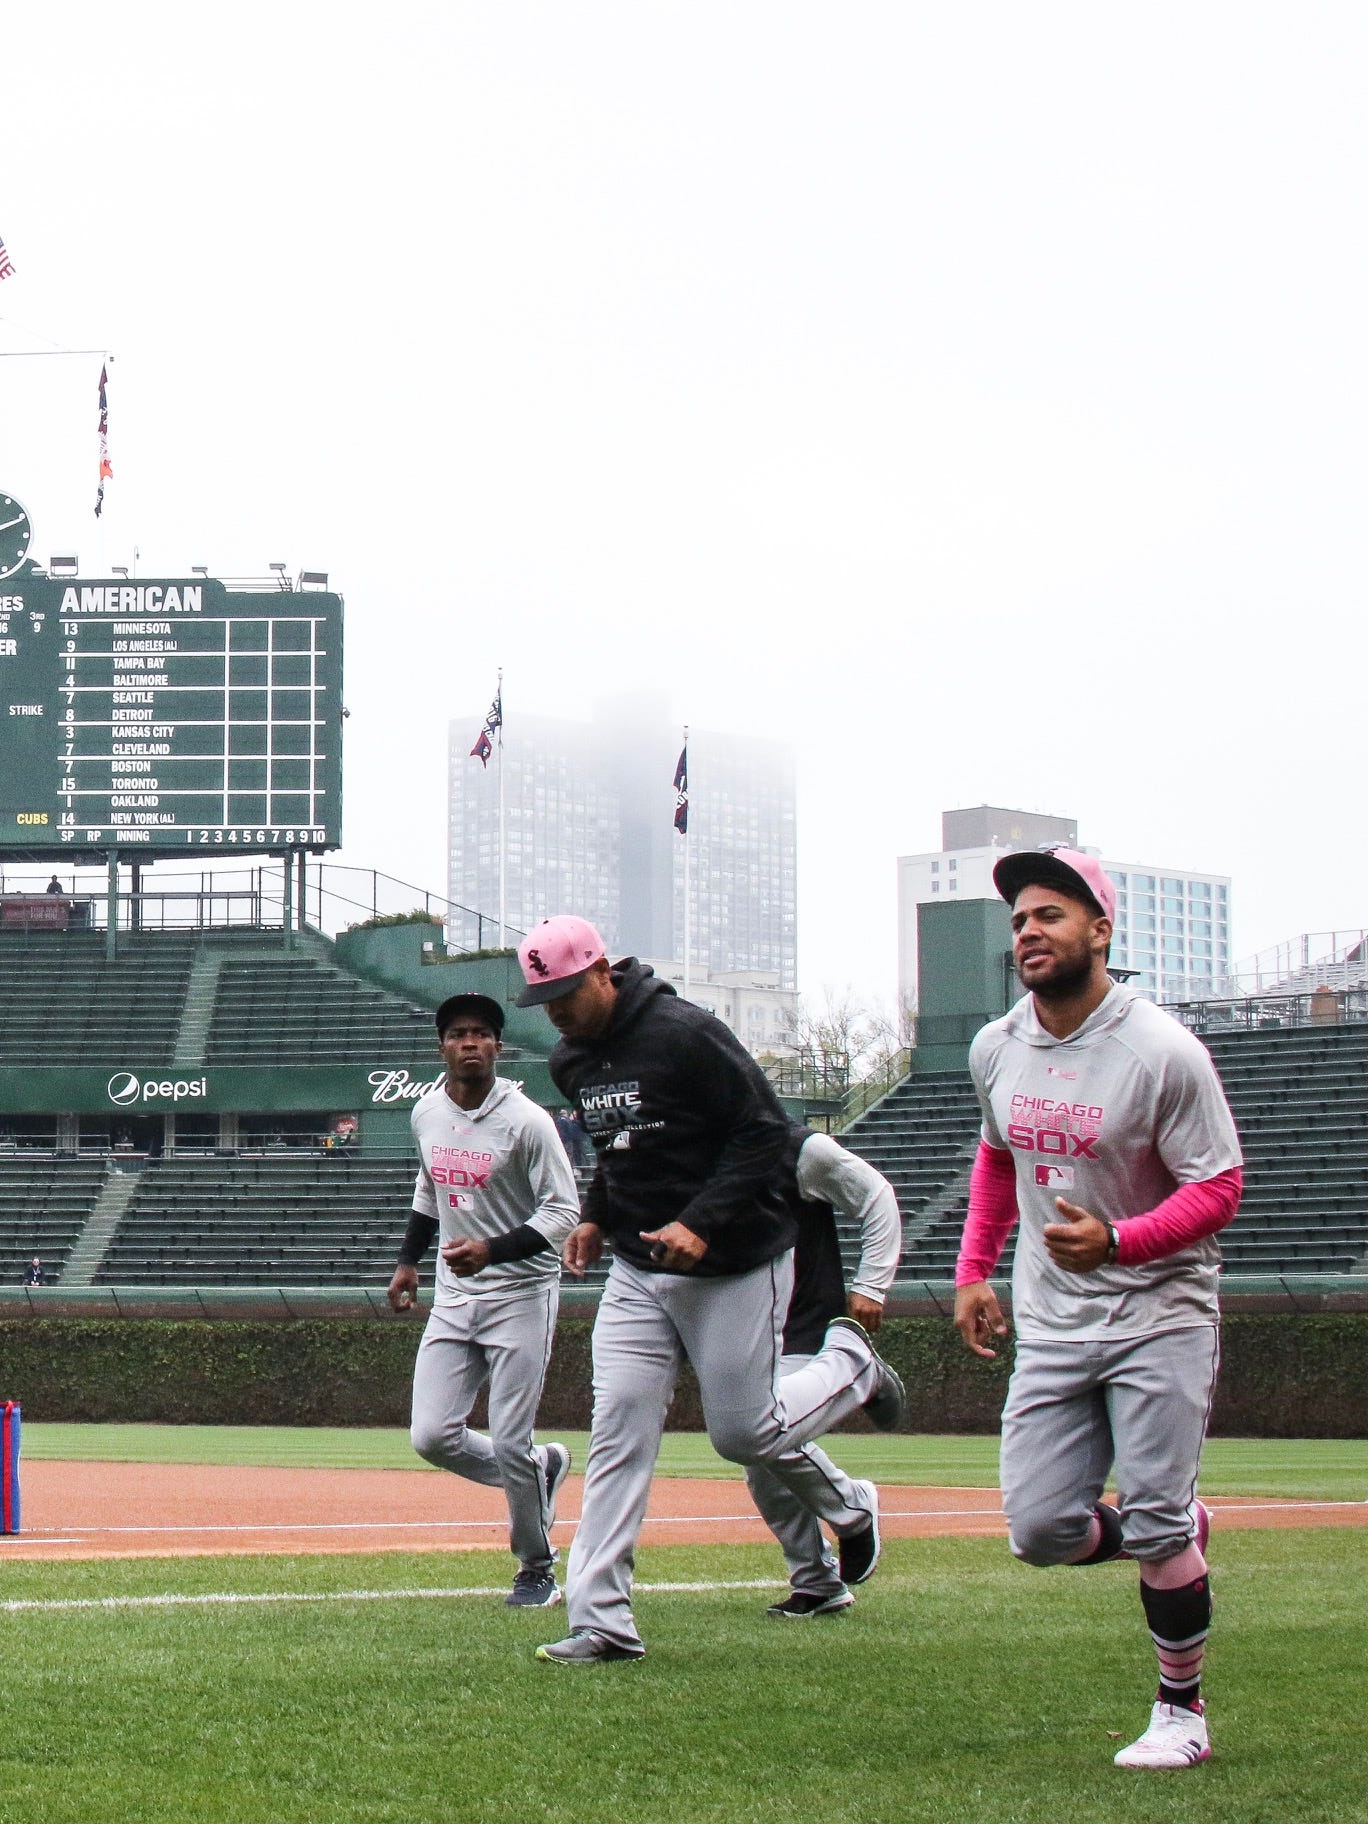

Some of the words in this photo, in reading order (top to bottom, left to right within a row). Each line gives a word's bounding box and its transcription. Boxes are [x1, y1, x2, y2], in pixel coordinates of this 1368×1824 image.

[59, 585, 202, 613] AMERICAN
[29, 611, 46, 621] 3RD
[33, 621, 42, 633] 9
[64, 622, 79, 636] 13
[113, 622, 172, 635] MINNESOTA
[66, 639, 76, 653] 9
[112, 639, 128, 652] LOS
[112, 657, 146, 670] TAMPA
[146, 657, 166, 670] BAY
[65, 674, 76, 687] 4
[113, 674, 169, 687] BALTIMORE
[65, 691, 75, 705] 7
[112, 691, 155, 704] SEATTLE
[8, 704, 44, 716] STRIKE
[65, 708, 75, 722] 8
[111, 708, 154, 721] DETROIT
[65, 725, 75, 739] 3
[111, 725, 151, 738] KANSAS
[152, 725, 175, 738] CITY
[65, 742, 75, 756] 7
[111, 742, 171, 755] CLEVELAND
[64, 760, 74, 774] 7
[111, 760, 151, 773] BOSTON
[61, 777, 76, 791] 15
[111, 777, 159, 790] TORONTO
[110, 794, 159, 808] OAKLAND
[16, 813, 49, 825] CUBS
[61, 812, 76, 826] 14
[110, 812, 133, 825] NEW
[60, 830, 75, 842] SP
[86, 830, 102, 842] RP
[116, 830, 151, 842] INNING
[199, 830, 209, 844] 2
[213, 830, 223, 844] 3
[227, 830, 238, 843] 4
[242, 829, 252, 843] 5
[256, 830, 266, 843] 6
[271, 830, 280, 843] 7
[285, 830, 295, 844] 8
[299, 830, 309, 843] 9
[312, 830, 326, 844] 10
[142, 1076, 207, 1102] pepsi
[581, 1092, 641, 1110] WHITE
[1012, 1094, 1103, 1118] CHICAGO
[1011, 1107, 1101, 1136] WHITE
[1008, 1124, 1100, 1160] SOX
[432, 1146, 491, 1161] CHICAGO
[431, 1167, 488, 1189] SOX
